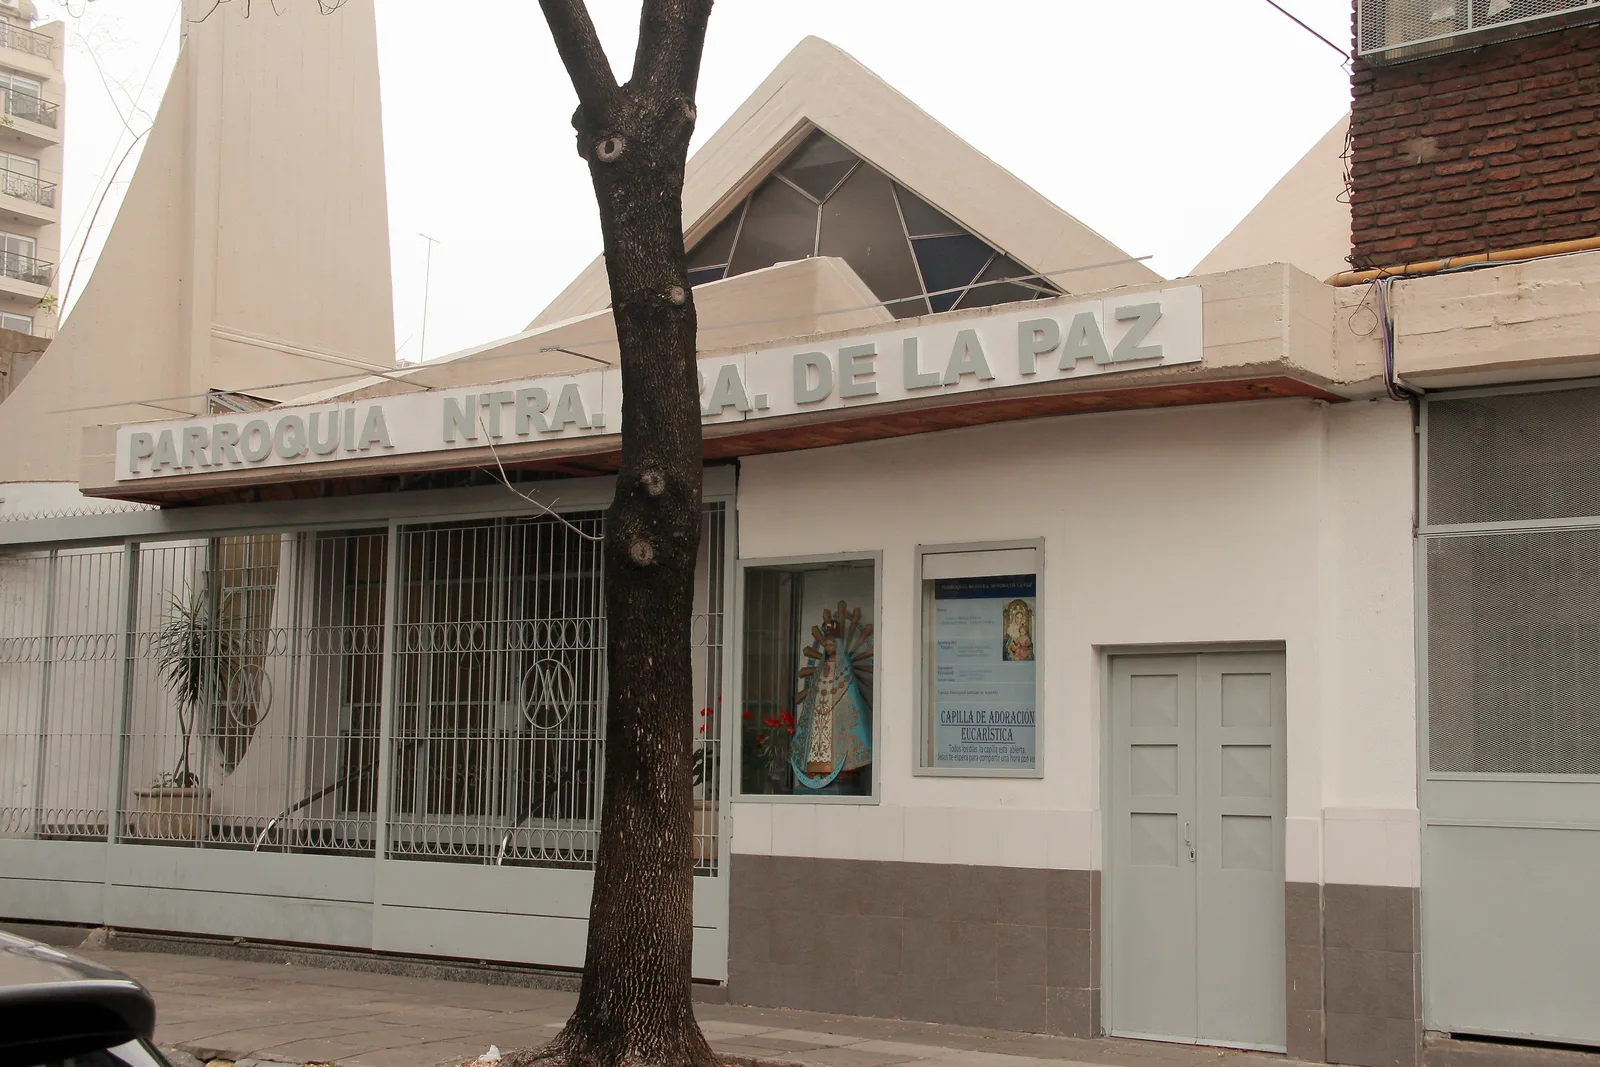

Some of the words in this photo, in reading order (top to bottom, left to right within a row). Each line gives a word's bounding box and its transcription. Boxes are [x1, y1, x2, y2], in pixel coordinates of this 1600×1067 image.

[129, 405, 394, 473] PARROQUIA
[443, 383, 606, 443] NTRA.
[697, 364, 770, 416] A.
[792, 343, 880, 405] DE
[903, 329, 996, 391] LA
[1018, 302, 1165, 376] PAZ
[940, 710, 974, 724] CAPILLA
[976, 710, 986, 724] DE
[988, 708, 1035, 724] ADORACIÓN
[961, 727, 1014, 741] EUCARÍSTICA
[949, 744, 961, 753] Todos
[954, 755, 969, 763] espera
[969, 755, 979, 763] para
